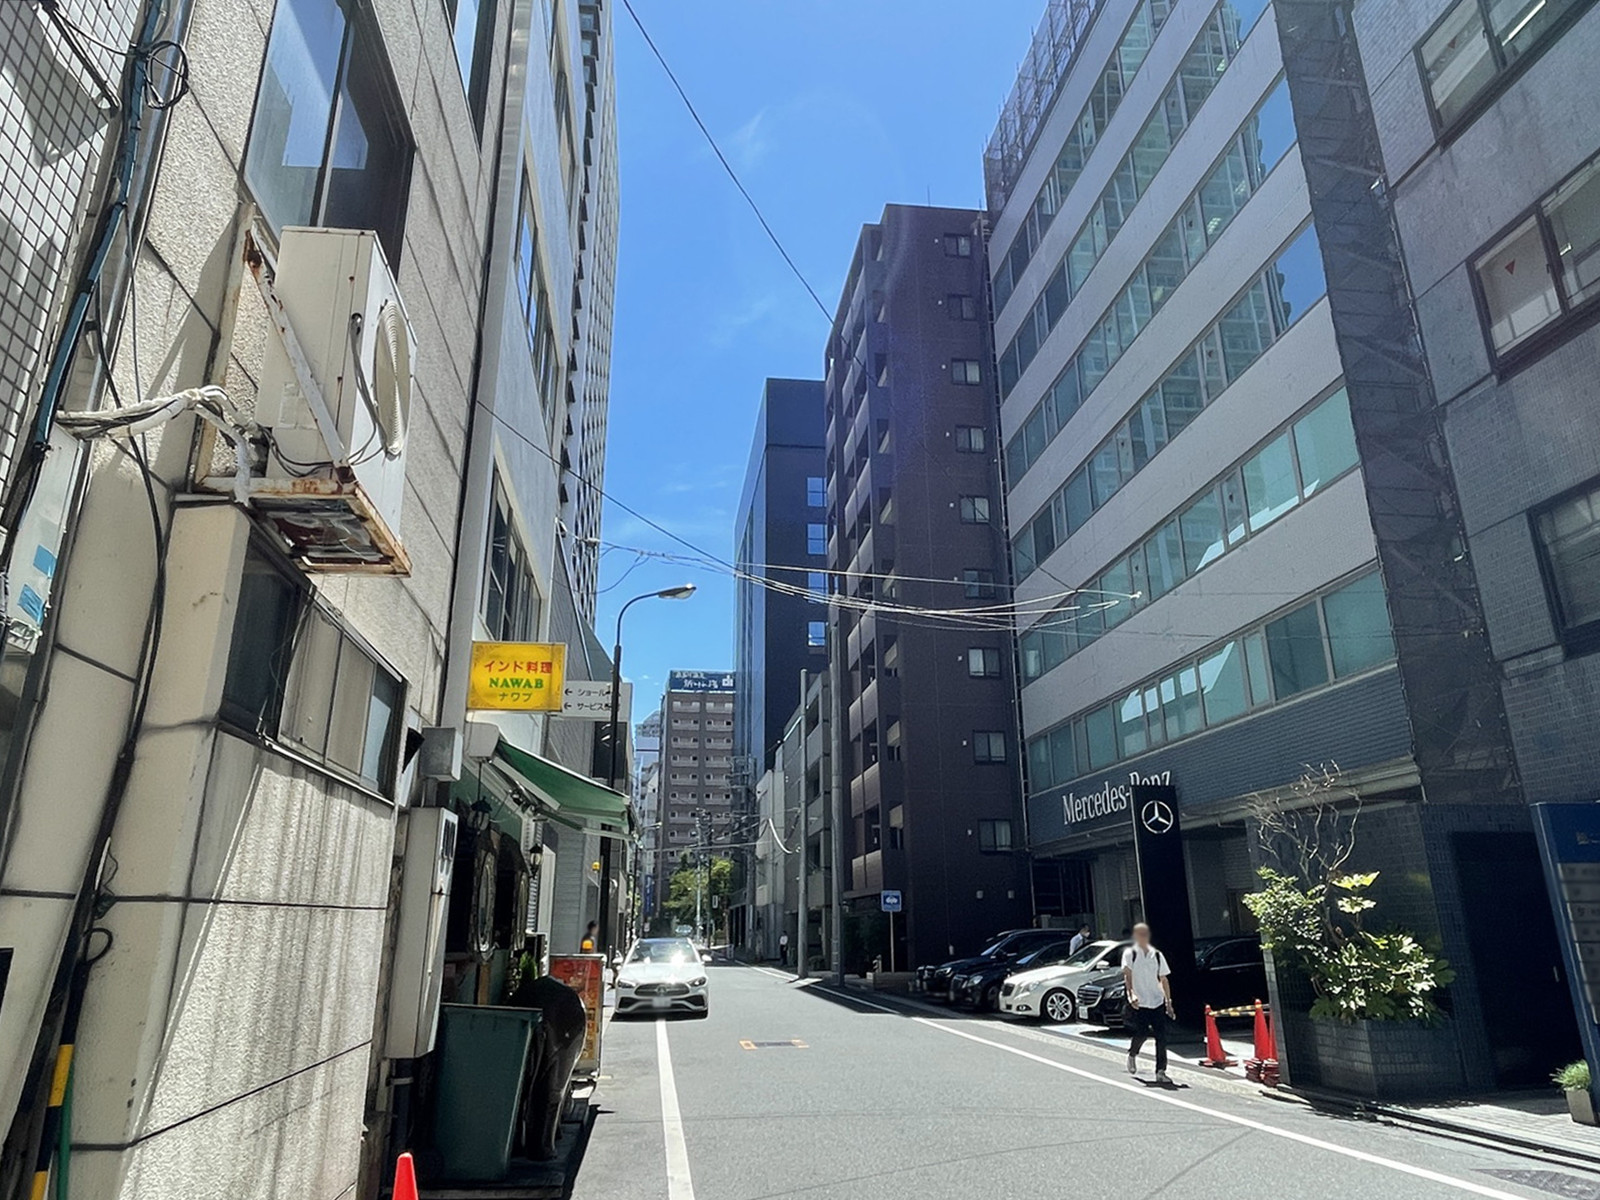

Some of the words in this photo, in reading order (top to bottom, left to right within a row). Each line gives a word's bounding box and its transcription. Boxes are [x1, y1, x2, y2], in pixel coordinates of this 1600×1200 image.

[484, 660, 553, 674] インド料理
[489, 677, 544, 689] NAWAB
[577, 688, 621, 697] ショール
[577, 702, 620, 711] サービス
[1062, 770, 1171, 825] Mercedes-z
